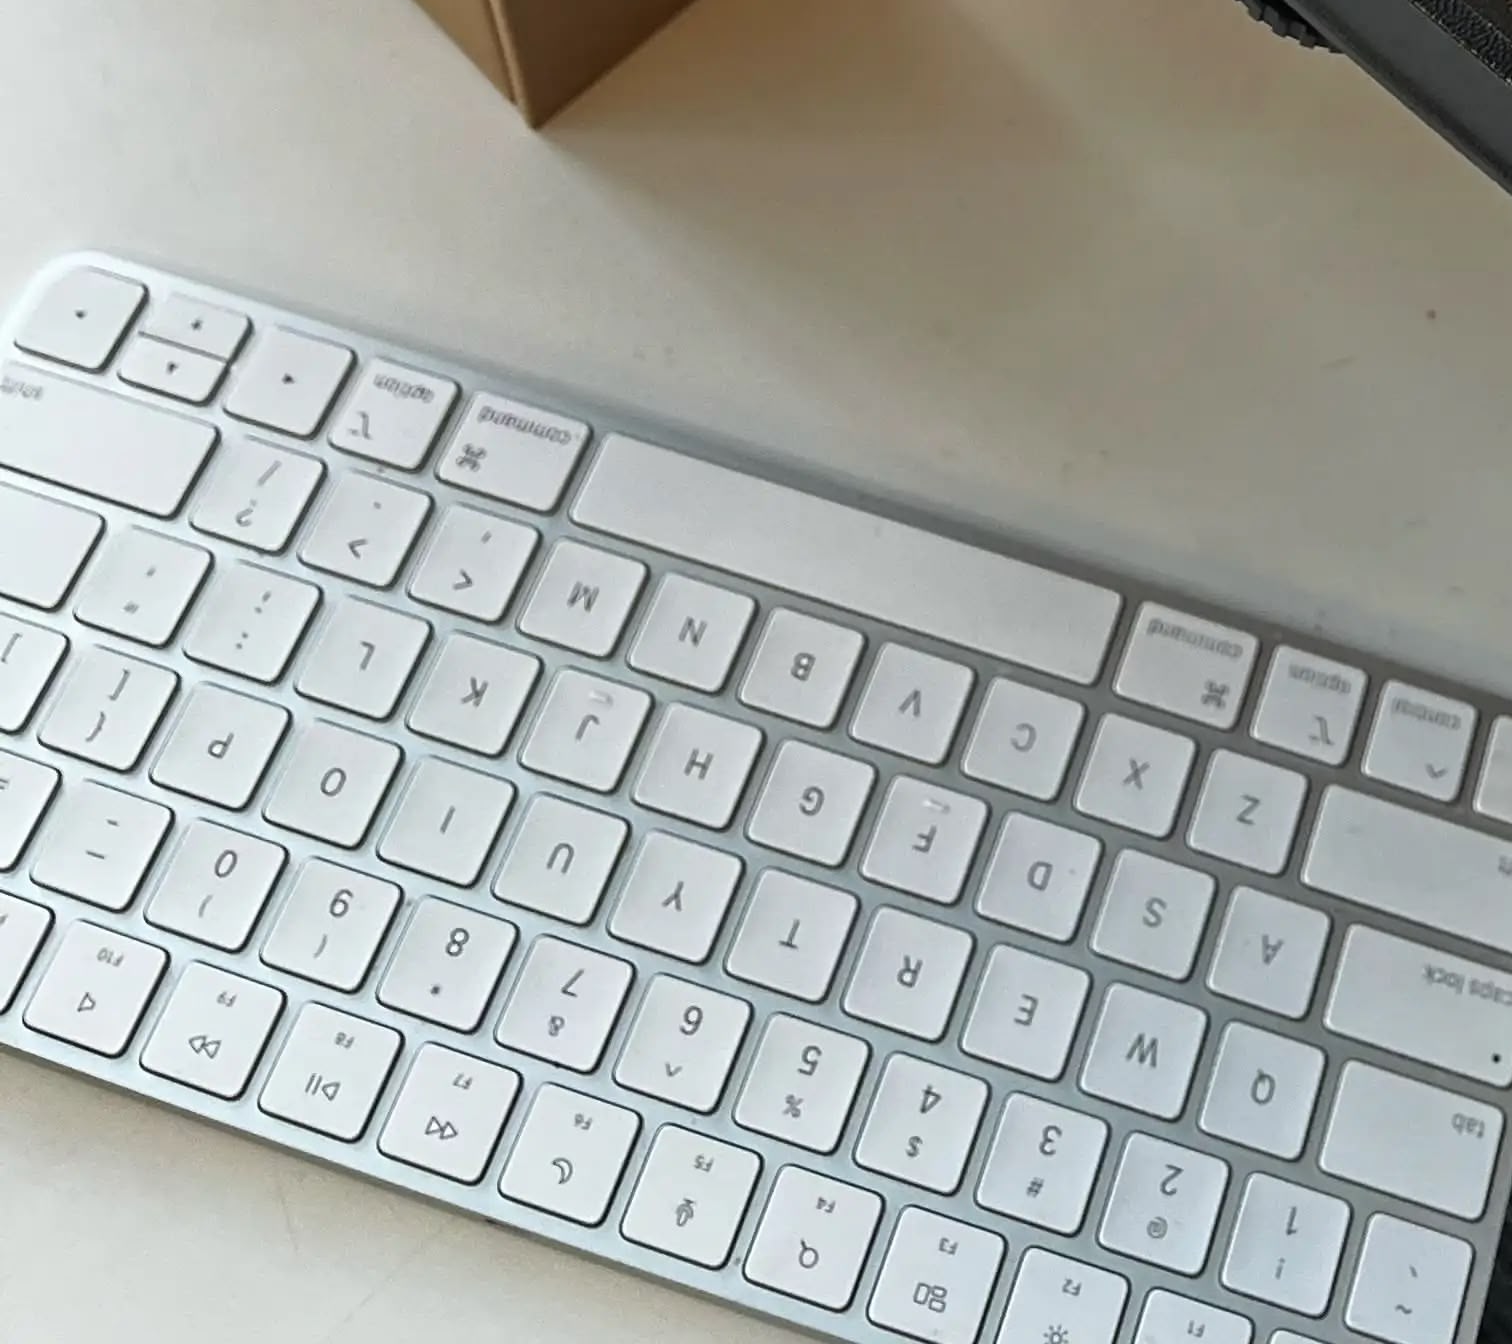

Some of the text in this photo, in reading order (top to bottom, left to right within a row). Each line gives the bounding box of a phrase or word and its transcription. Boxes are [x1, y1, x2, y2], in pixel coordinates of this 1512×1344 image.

[566, 580, 601, 614] M
[677, 615, 708, 649] N
[359, 640, 377, 672] L
[789, 651, 817, 683] B
[460, 676, 489, 709] K
[897, 688, 922, 719] V
[574, 713, 601, 742] J
[1010, 722, 1037, 753] C
[206, 731, 235, 760] P
[683, 747, 715, 781] H
[1122, 757, 1151, 791] X
[319, 766, 348, 798] O
[798, 785, 826, 817] G
[1235, 793, 1262, 827] Z
[439, 805, 457, 835] I
[911, 824, 938, 855] F
[213, 848, 239, 880] 0
[545, 842, 575, 876] U
[1026, 860, 1054, 893] D
[328, 887, 355, 920] 9
[660, 880, 685, 913] Y
[1142, 896, 1168, 929] S
[444, 927, 471, 958] 8
[777, 918, 801, 951] T
[1260, 933, 1286, 966] A
[559, 968, 585, 999] 7
[896, 954, 924, 990] R
[1422, 963, 1465, 991] lock
[678, 1004, 704, 1037] 6
[1012, 993, 1040, 1028] E
[796, 1044, 823, 1077] 5
[1124, 1032, 1160, 1070] W
[451, 1071, 474, 1091] F7
[1249, 1068, 1277, 1107] Q
[781, 1093, 805, 1120] %
[918, 1083, 943, 1115] 4
[1038, 1124, 1064, 1158] 3
[1451, 1112, 1486, 1140] tab
[692, 1153, 716, 1174] F5
[904, 1135, 924, 1161] $
[1025, 1176, 1045, 1199] #
[1159, 1163, 1185, 1198] 2
[815, 1195, 837, 1215] F4
[1284, 1205, 1299, 1237] 1
[1145, 1215, 1169, 1240] @
[937, 1236, 960, 1257] F3
[1061, 1277, 1083, 1297] F2
